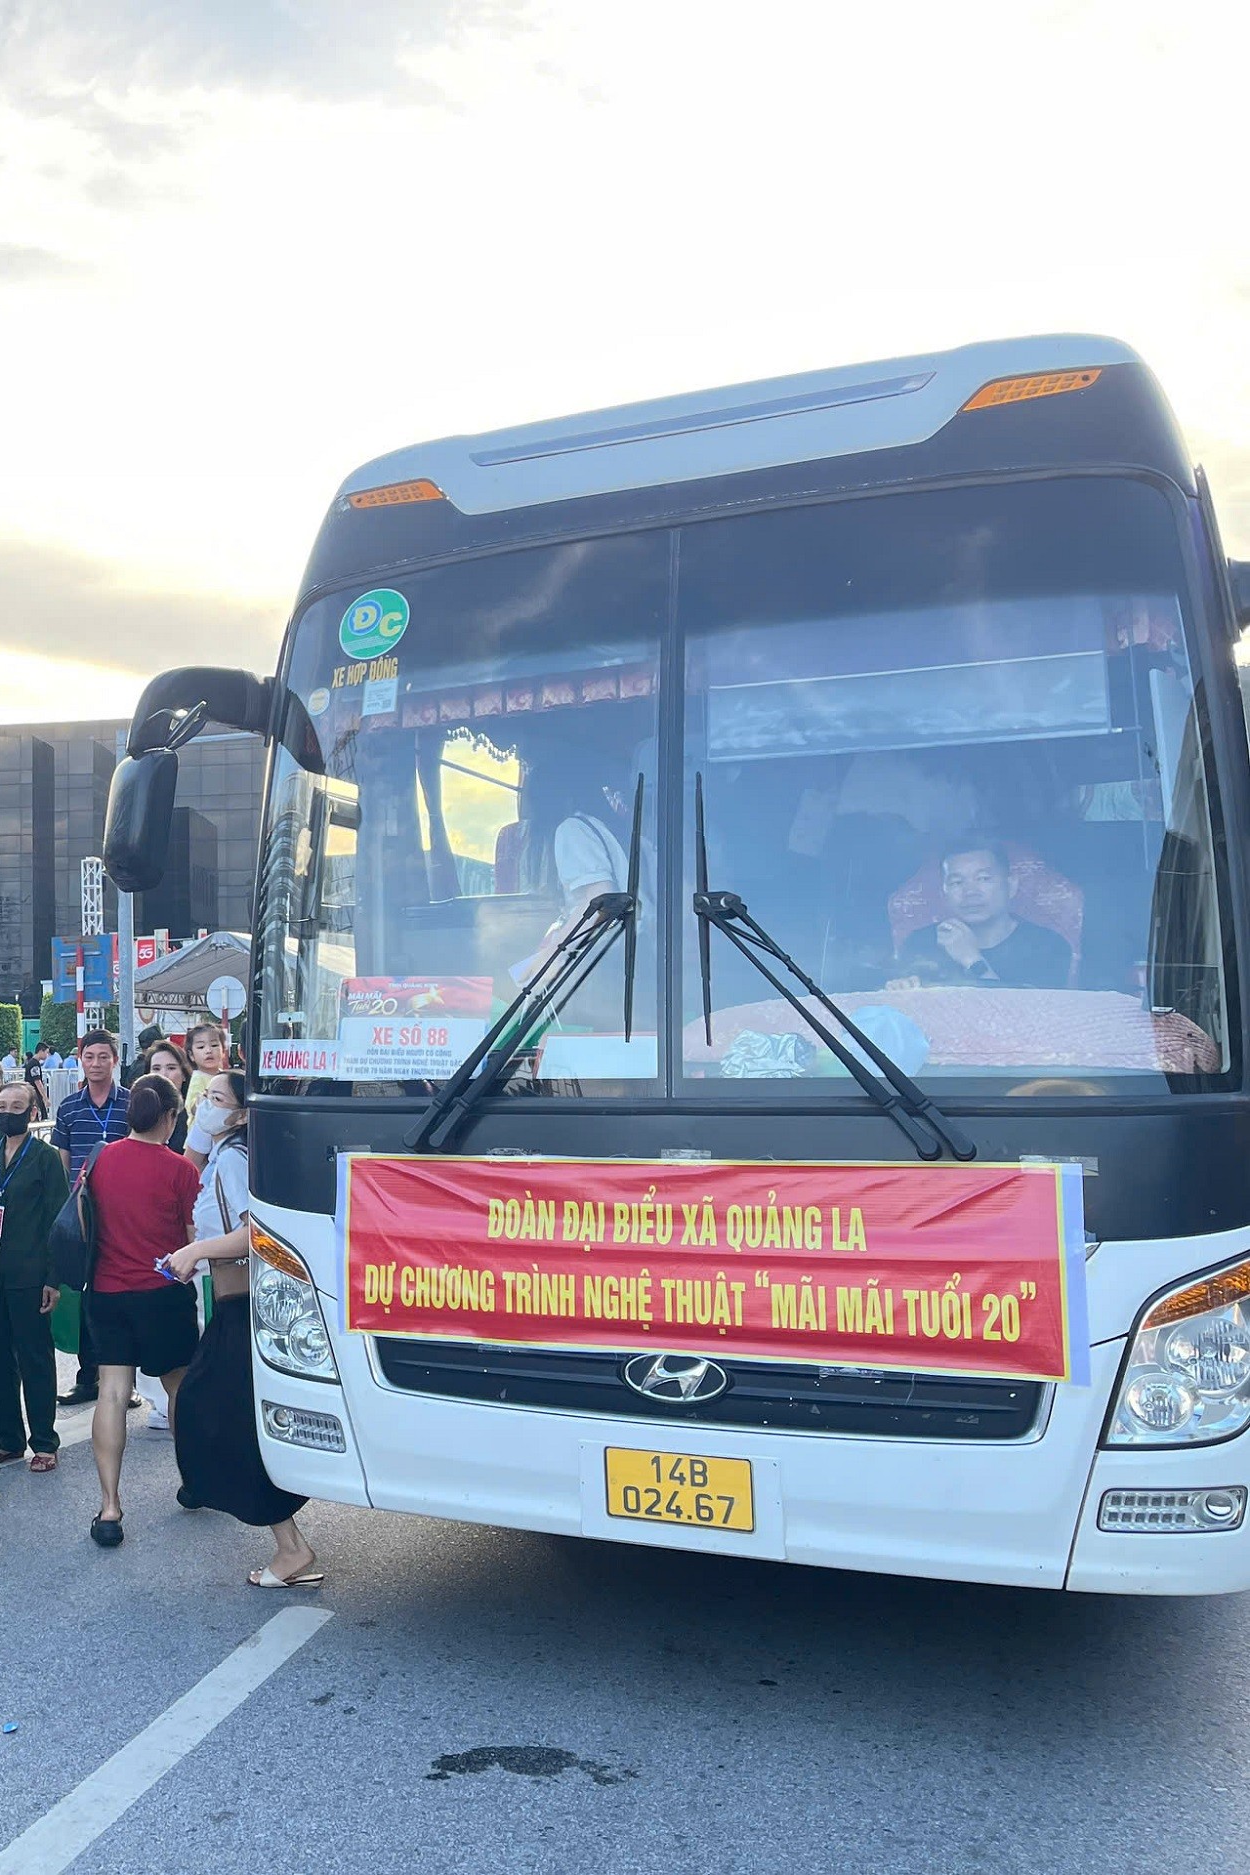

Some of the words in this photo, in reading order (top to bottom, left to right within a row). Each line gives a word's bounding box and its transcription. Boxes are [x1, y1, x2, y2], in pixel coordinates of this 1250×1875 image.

[332, 666, 345, 689] XE
[138, 947, 153, 960] 5G
[368, 998, 398, 1016] 20
[372, 1026, 393, 1046] XE
[399, 1020, 422, 1046] SỐ
[427, 1027, 448, 1047] 88
[262, 1050, 273, 1069] XE
[275, 1044, 312, 1070] QUẢNG
[313, 1050, 327, 1070] LA
[488, 1190, 556, 1240] ĐOÀN
[562, 1200, 605, 1252] ĐẠI
[613, 1185, 673, 1245] BIỂU
[680, 1195, 718, 1246] XÃ
[726, 1190, 823, 1252] QUẢNG
[832, 1207, 868, 1251] LA
[364, 1261, 397, 1314] DỰ
[400, 1263, 496, 1312] CHƯƠNG
[502, 1263, 576, 1317] TRÌNH
[584, 1268, 653, 1330] NGHỆ
[661, 1271, 746, 1335] THUẬT
[836, 1278, 895, 1336] MÃI
[902, 1272, 972, 1340] TUỔI
[651, 1455, 708, 1488] 14B
[623, 1485, 735, 1524] 024.67
